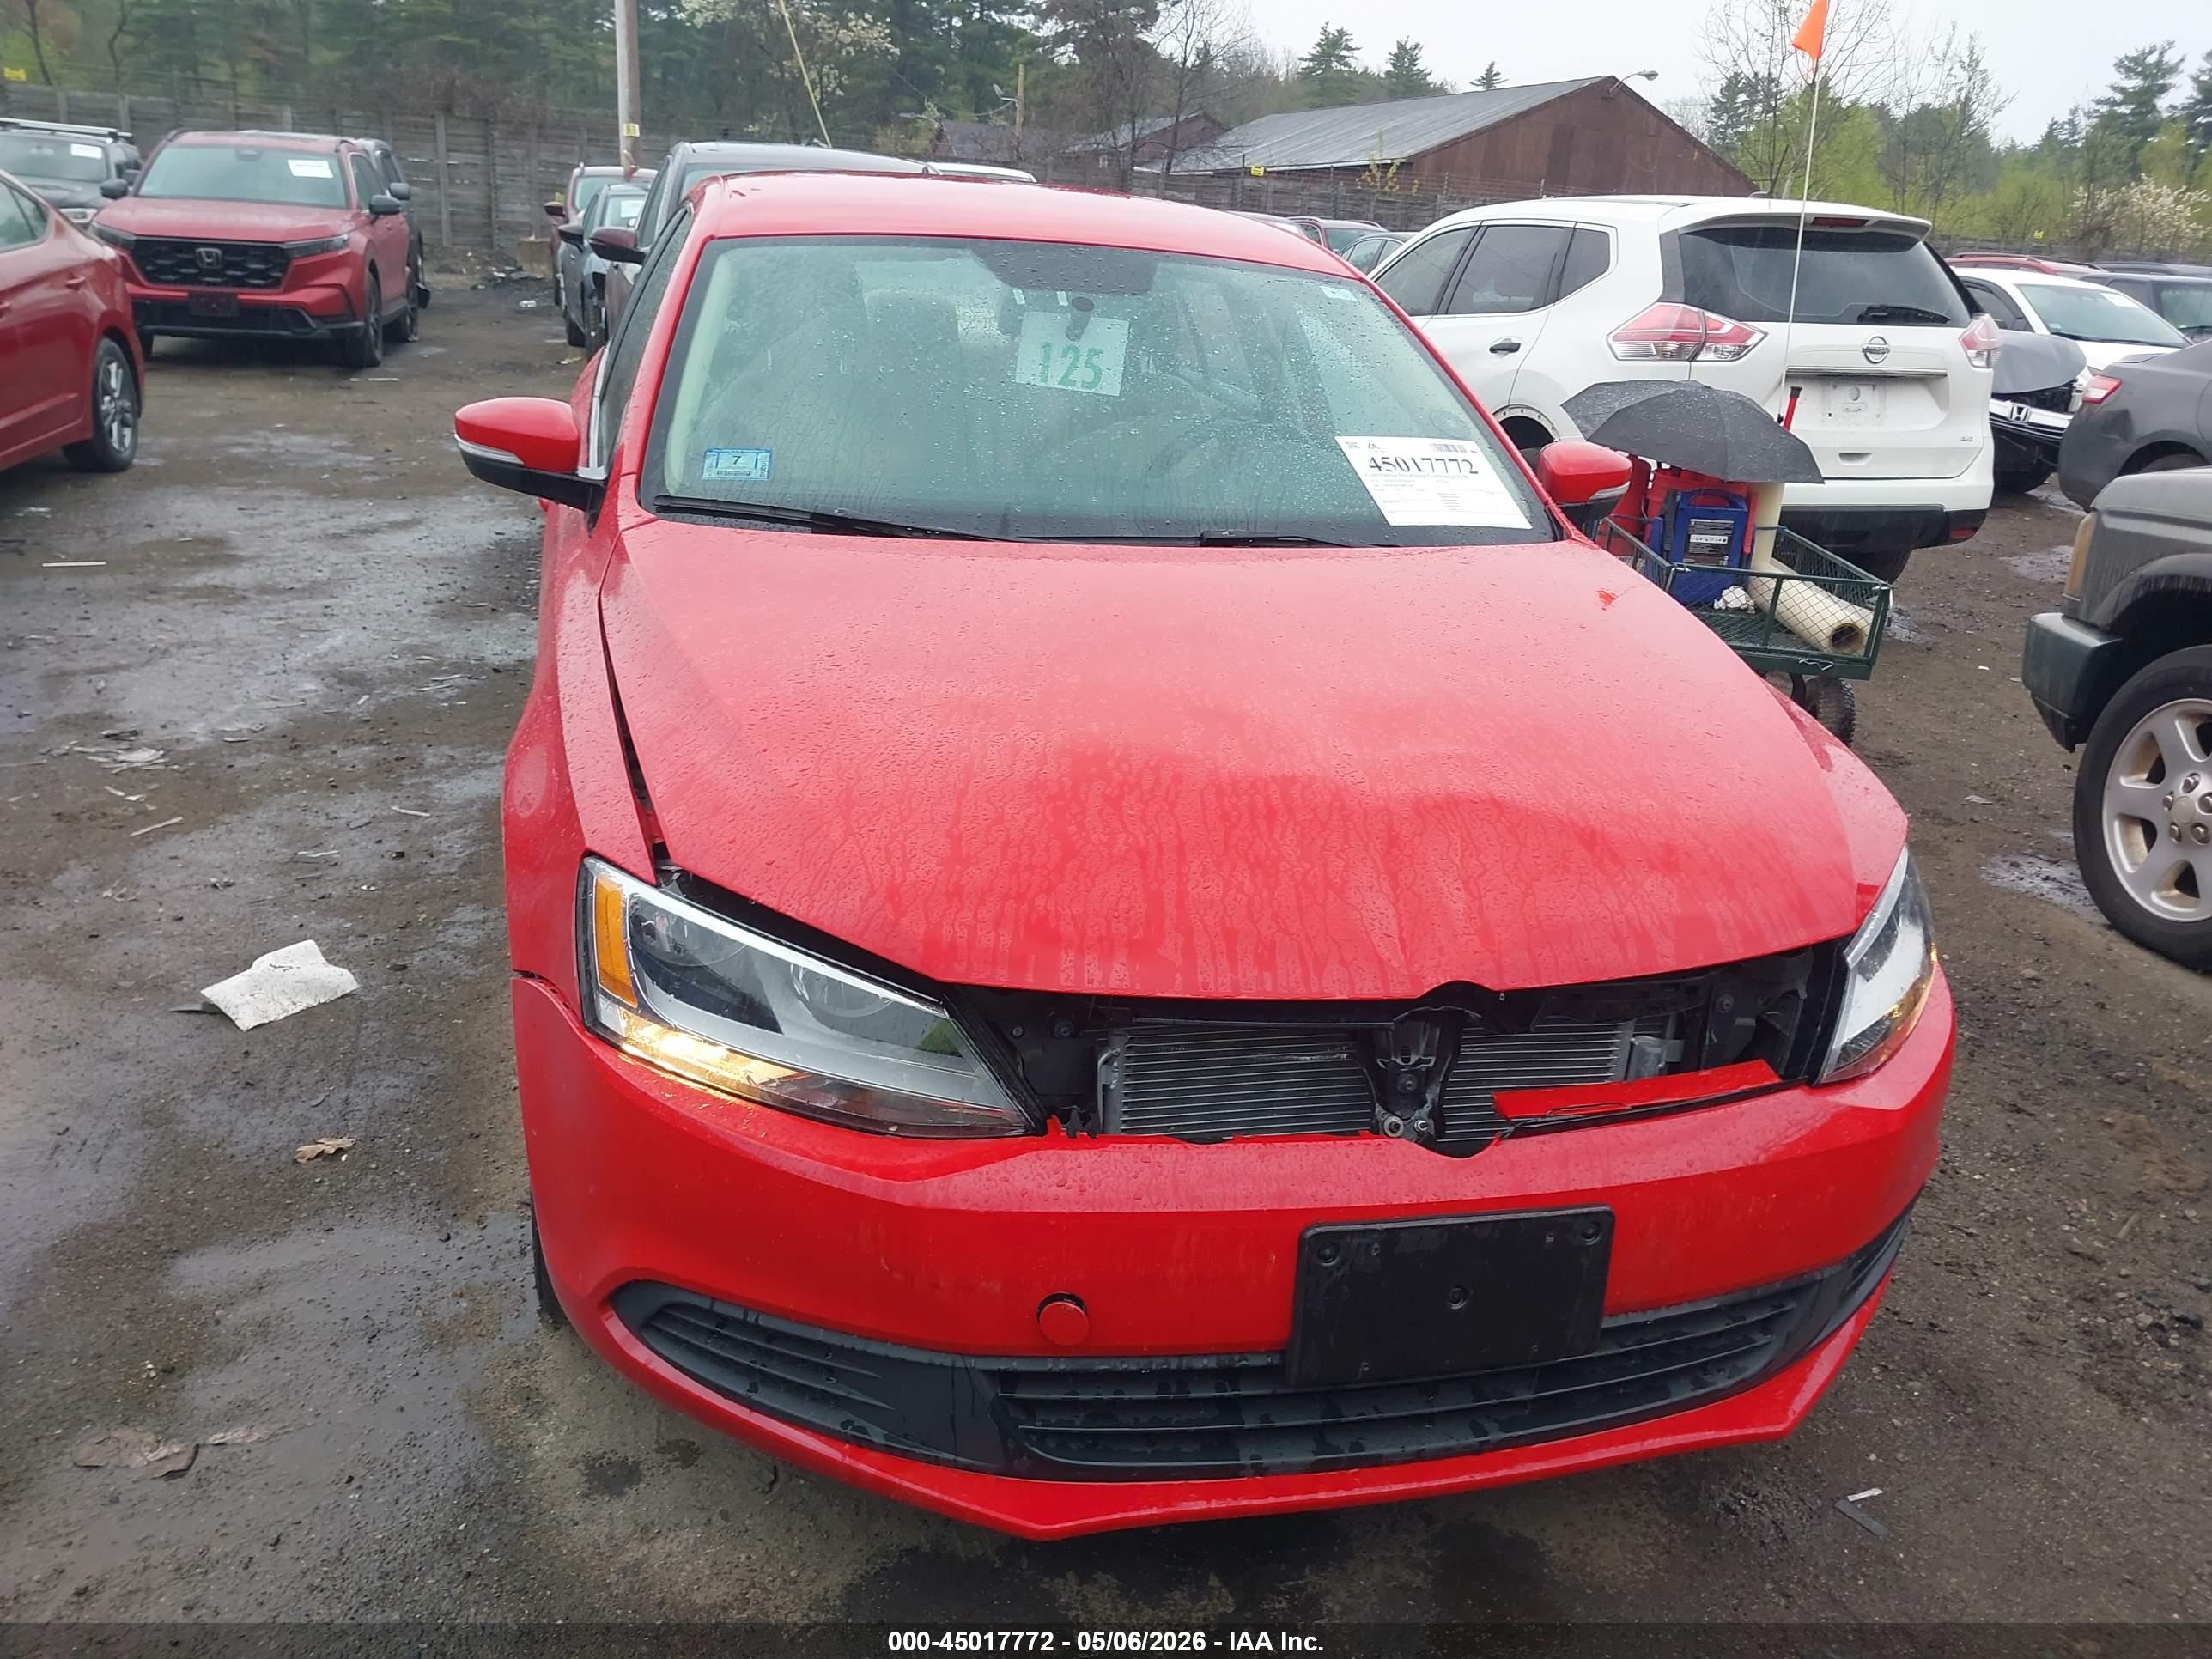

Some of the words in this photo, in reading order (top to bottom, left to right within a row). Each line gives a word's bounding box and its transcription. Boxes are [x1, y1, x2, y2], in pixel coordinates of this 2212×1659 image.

[1039, 343, 1104, 389] 125
[732, 456, 742, 465] 7
[1369, 456, 1479, 475] 45017772
